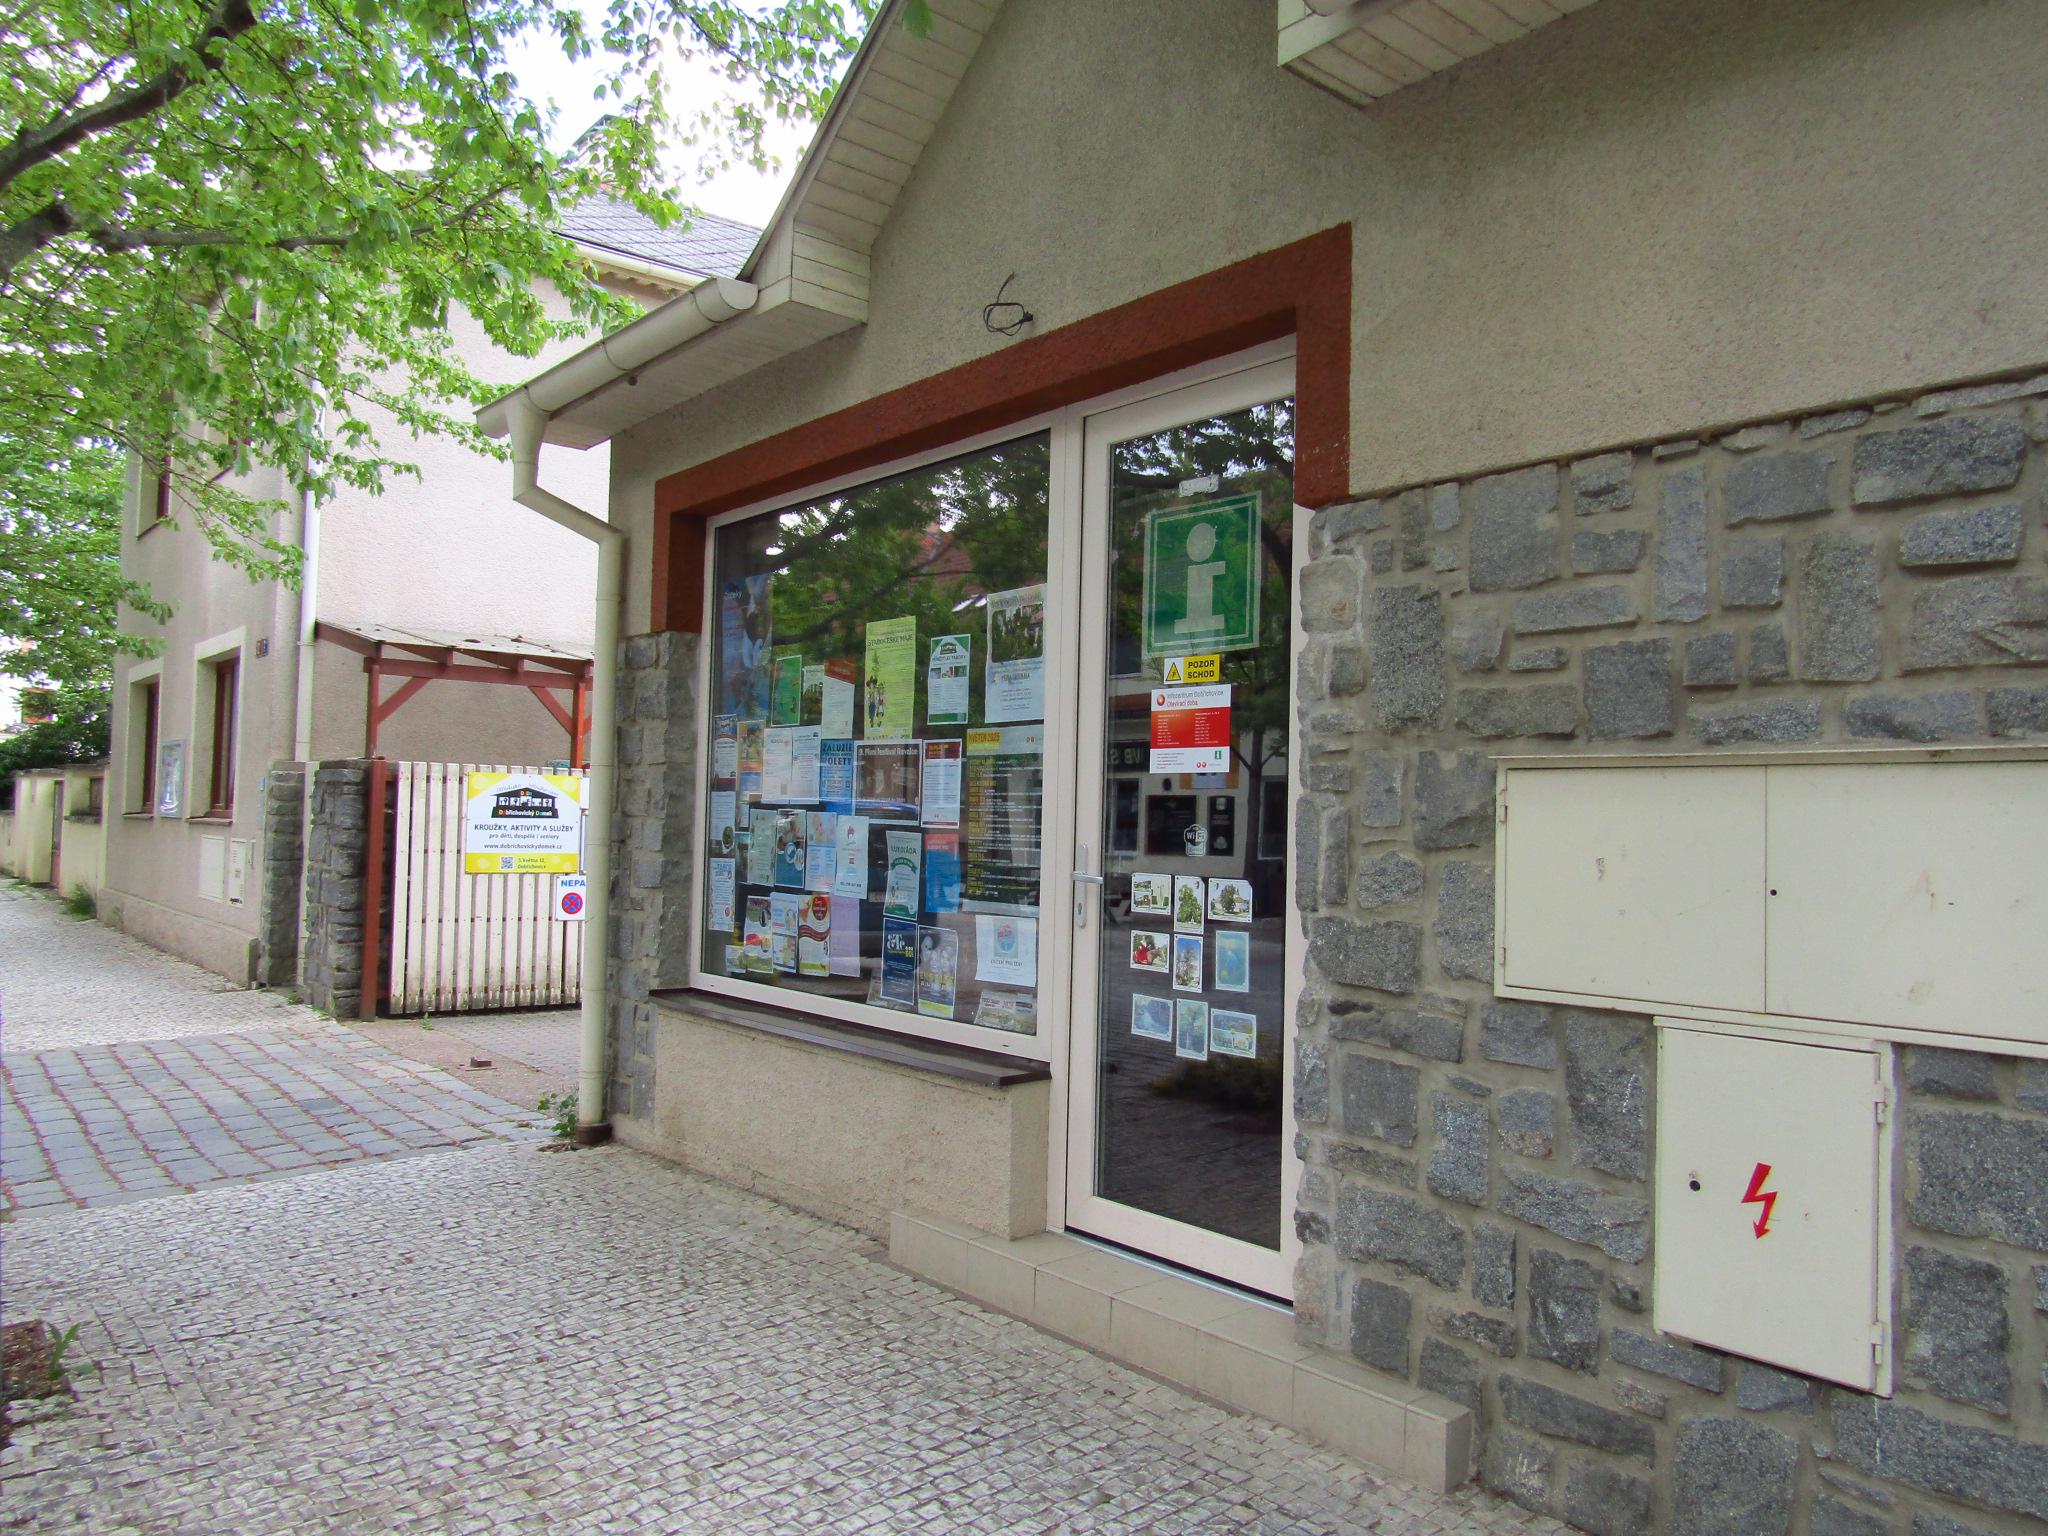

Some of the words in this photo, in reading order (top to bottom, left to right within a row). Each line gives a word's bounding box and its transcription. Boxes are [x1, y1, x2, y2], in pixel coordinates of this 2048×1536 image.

[1187, 660, 1215, 668] POZOR
[1187, 670, 1215, 679] SCHOD
[474, 823, 508, 832] KROUŽKY,
[510, 824, 541, 832] AKTIVITY
[549, 823, 574, 832] SLUŽBY
